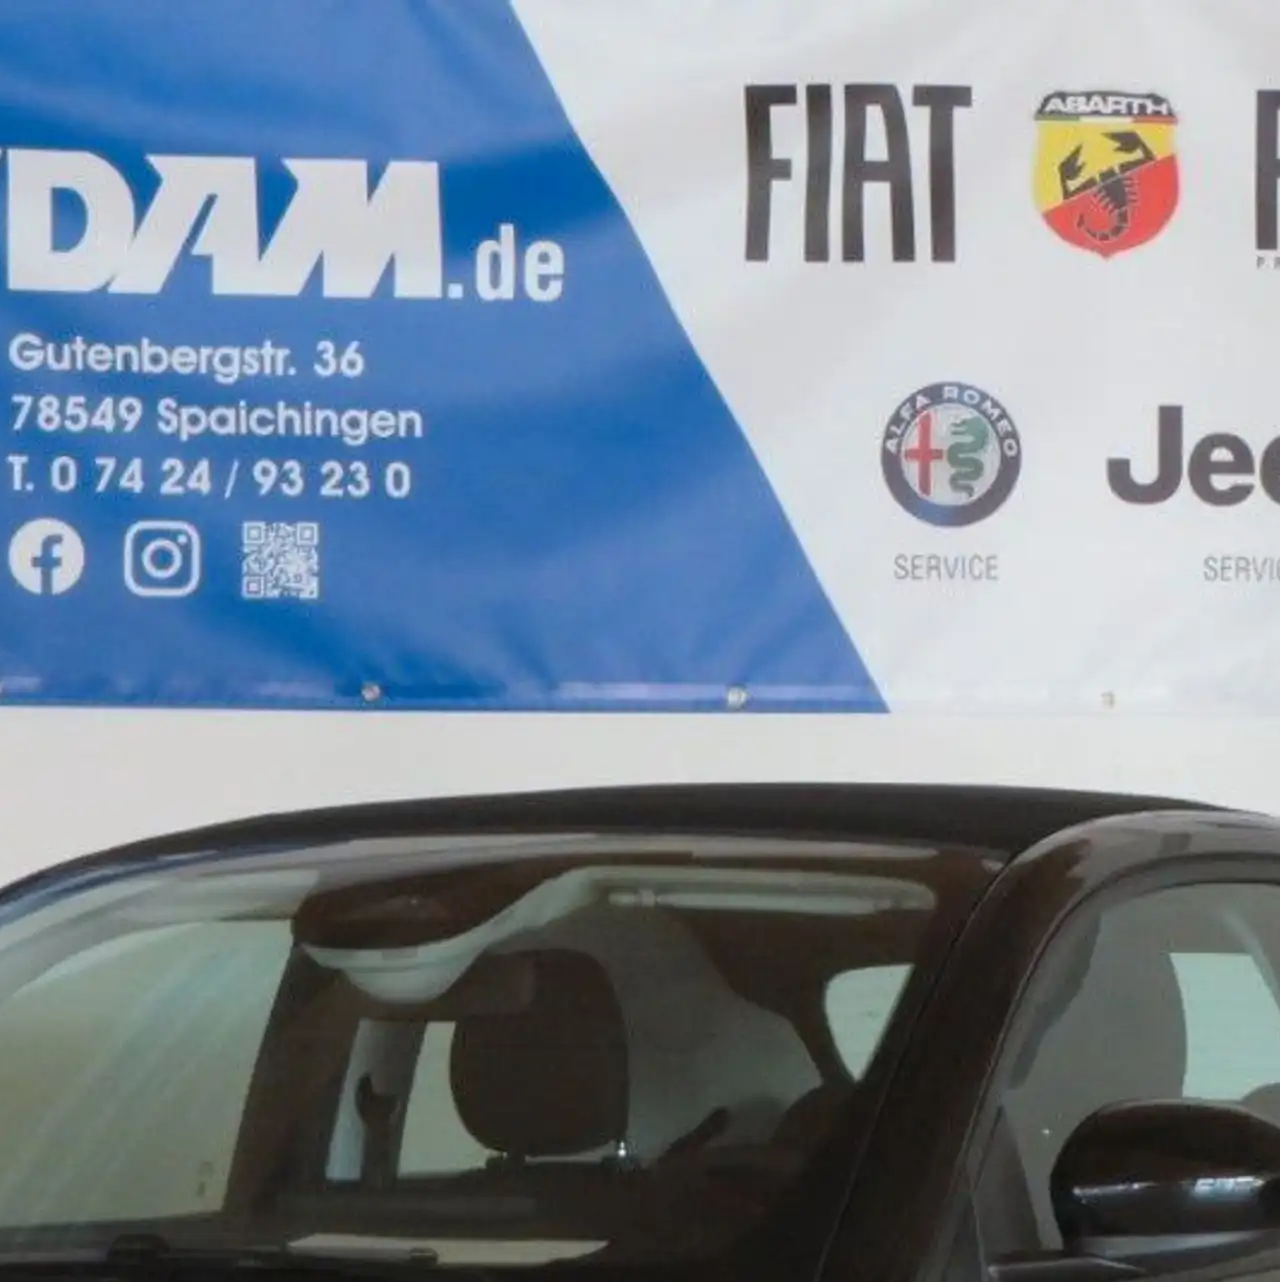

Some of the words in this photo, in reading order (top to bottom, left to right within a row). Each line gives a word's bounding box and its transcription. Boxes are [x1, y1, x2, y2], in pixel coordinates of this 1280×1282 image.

[1044, 95, 1170, 116] ABARTH
[745, 84, 972, 262] FIAT
[8, 333, 297, 384] Gutenbergstr.
[313, 340, 365, 378] 36
[11, 394, 143, 433] 78549
[157, 398, 423, 446] Spaichingen
[886, 394, 931, 454] ALFA
[943, 386, 1018, 457] ROMEO
[7, 455, 35, 491] T.
[94, 456, 145, 493] 74
[160, 458, 211, 495] 24
[253, 460, 304, 496] 93
[320, 461, 371, 498] 23
[894, 555, 999, 581] SERVICE
